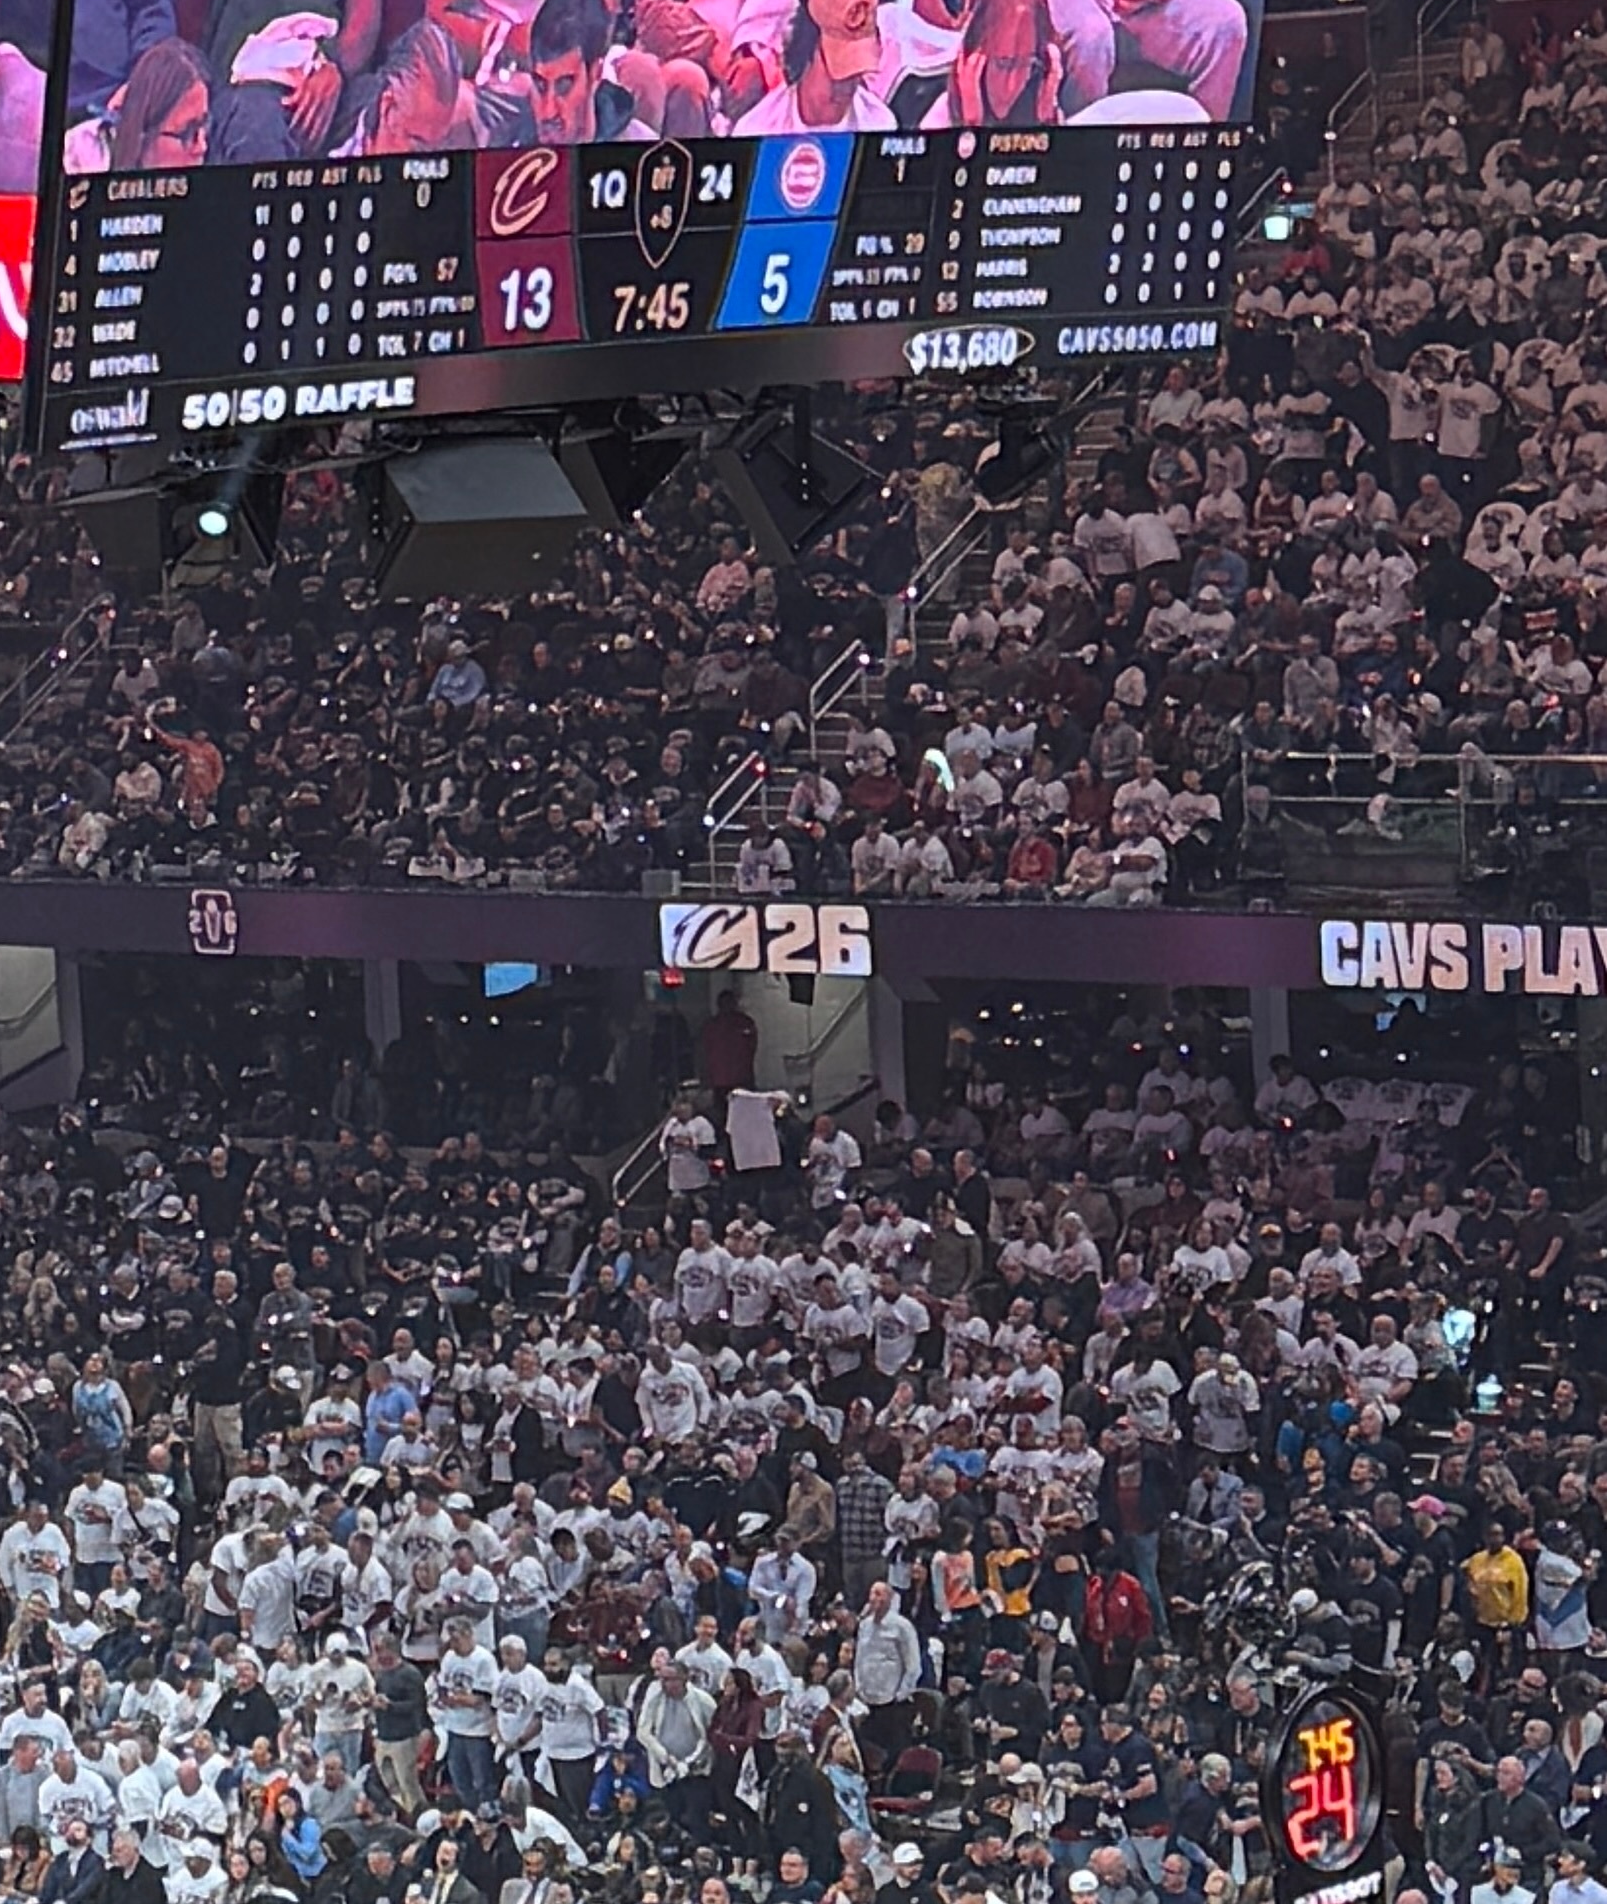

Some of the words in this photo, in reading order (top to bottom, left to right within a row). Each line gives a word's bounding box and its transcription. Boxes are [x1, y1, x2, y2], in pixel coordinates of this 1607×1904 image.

[589, 170, 628, 208] 1Q
[698, 164, 734, 202] 24
[500, 266, 553, 331] 13
[613, 281, 690, 333] 7:45
[760, 253, 791, 315] 5
[910, 327, 1019, 376] $13,680
[294, 376, 415, 417] RAFFLE
[765, 905, 873, 976] 26
[1319, 918, 1468, 991] CAVS
[1483, 921, 1607, 996] PLA
[1287, 1765, 1355, 1863] 24
